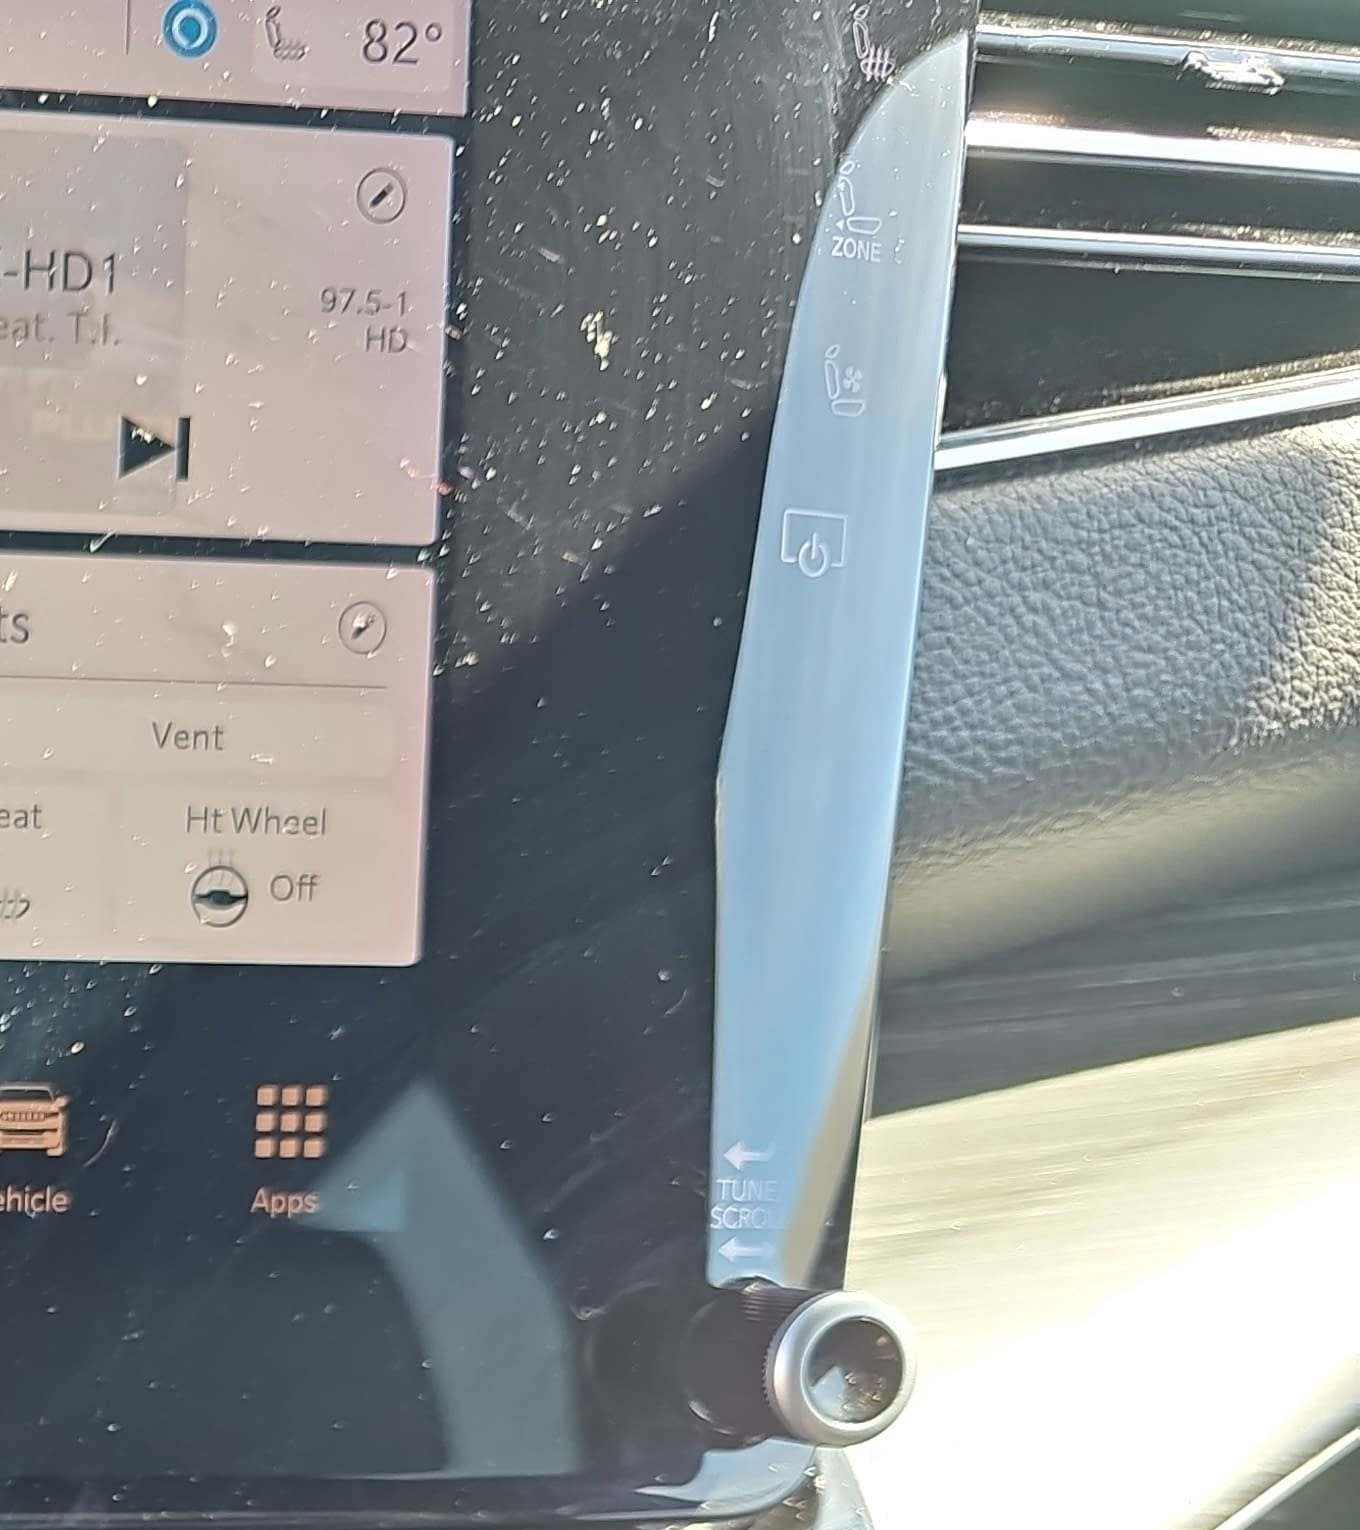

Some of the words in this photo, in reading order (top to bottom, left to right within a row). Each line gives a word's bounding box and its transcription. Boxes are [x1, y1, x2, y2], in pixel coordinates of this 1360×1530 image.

[831, 235, 882, 263] ZONE
[321, 288, 409, 316] 97.5-1
[67, 313, 120, 346] T.I.
[364, 327, 409, 354] HD
[152, 721, 225, 751] Vent
[186, 805, 224, 834] Ht
[231, 807, 327, 837] Wheel
[270, 873, 320, 902] Off
[250, 1188, 320, 1218] Apps
[716, 1178, 778, 1202] TUNE
[709, 1206, 784, 1229] SCRO
